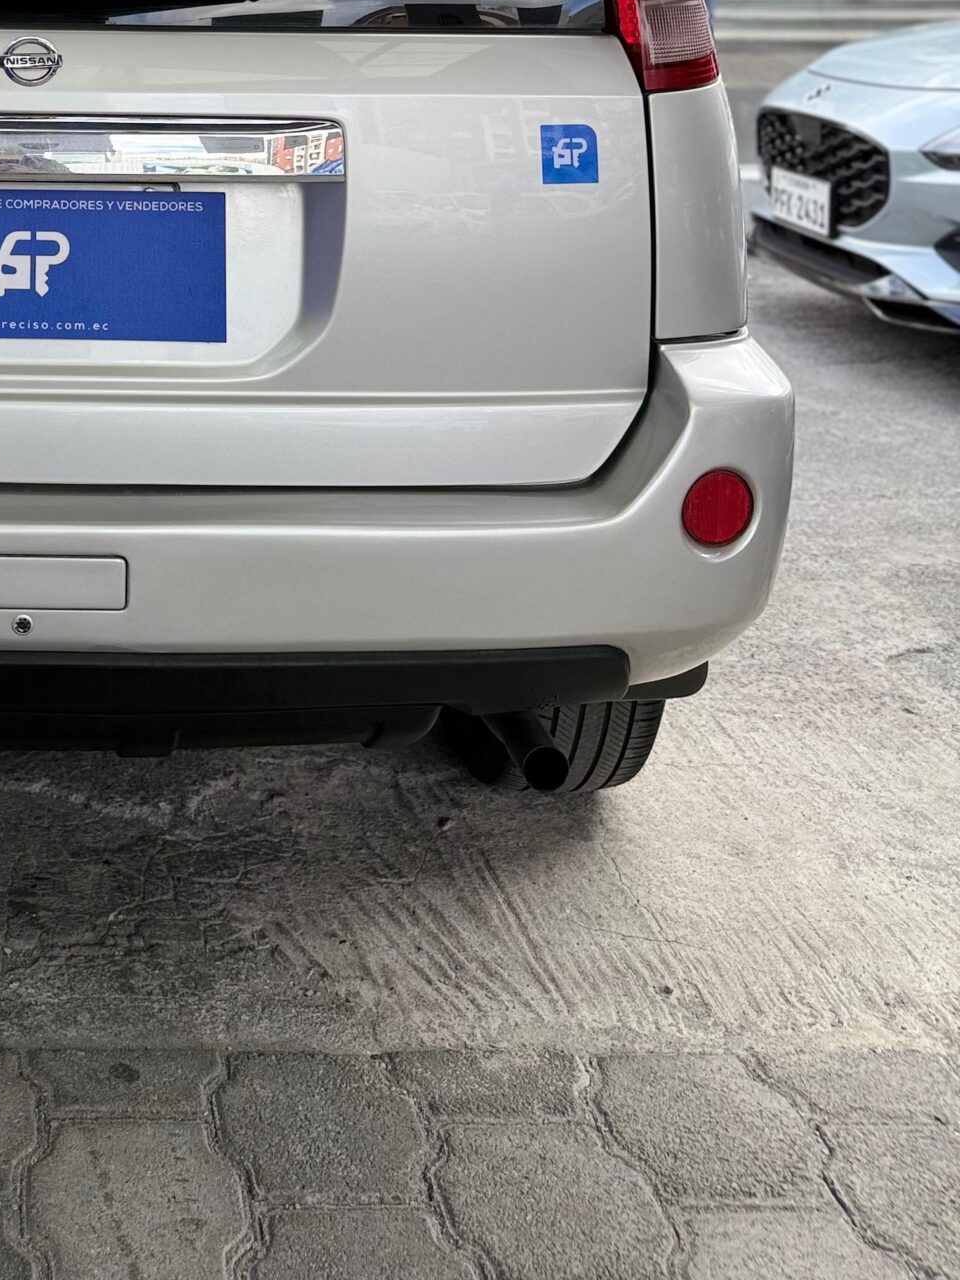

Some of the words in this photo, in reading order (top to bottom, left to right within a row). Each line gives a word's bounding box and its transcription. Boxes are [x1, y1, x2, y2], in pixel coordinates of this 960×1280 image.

[6, 56, 56, 65] NISSAN
[5, 199, 104, 211] COMPRADORES
[106, 200, 115, 210] Y
[116, 201, 204, 212] VENDEDORES
